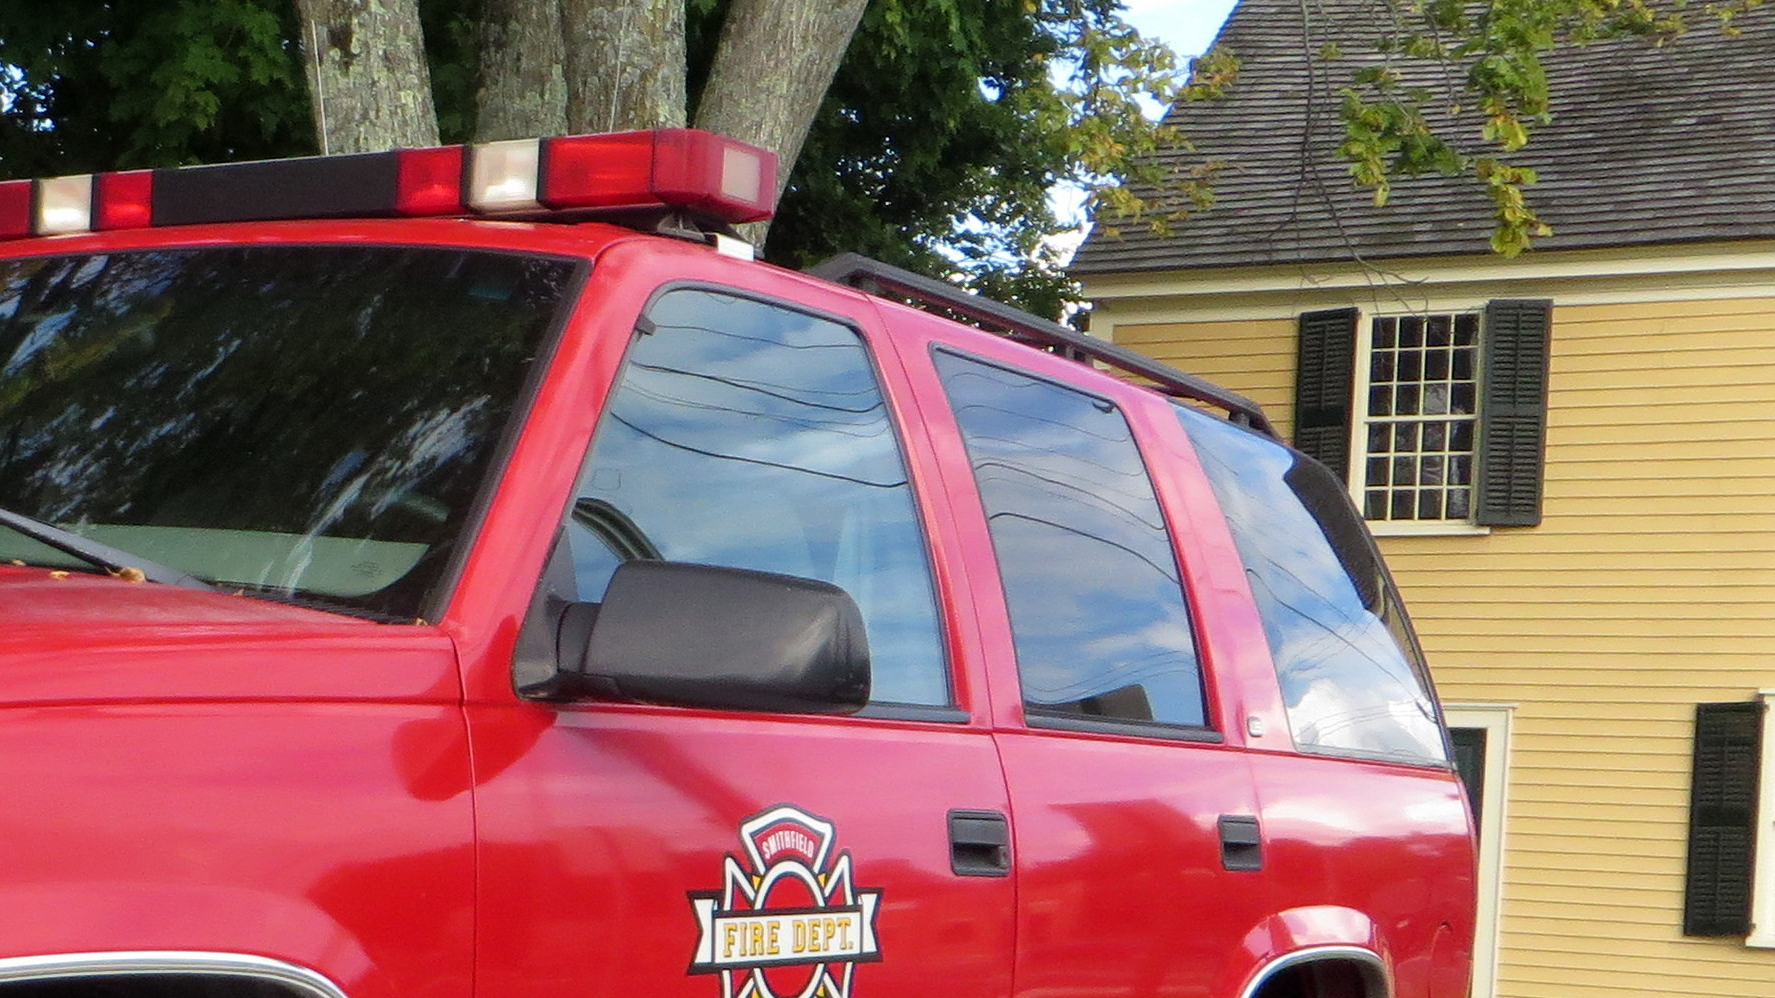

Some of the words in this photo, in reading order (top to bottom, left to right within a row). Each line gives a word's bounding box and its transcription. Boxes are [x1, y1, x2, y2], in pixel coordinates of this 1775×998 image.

[761, 829, 815, 860] SMITHFIELD
[723, 920, 780, 957] FIRE
[792, 918, 854, 952] DEPT.
